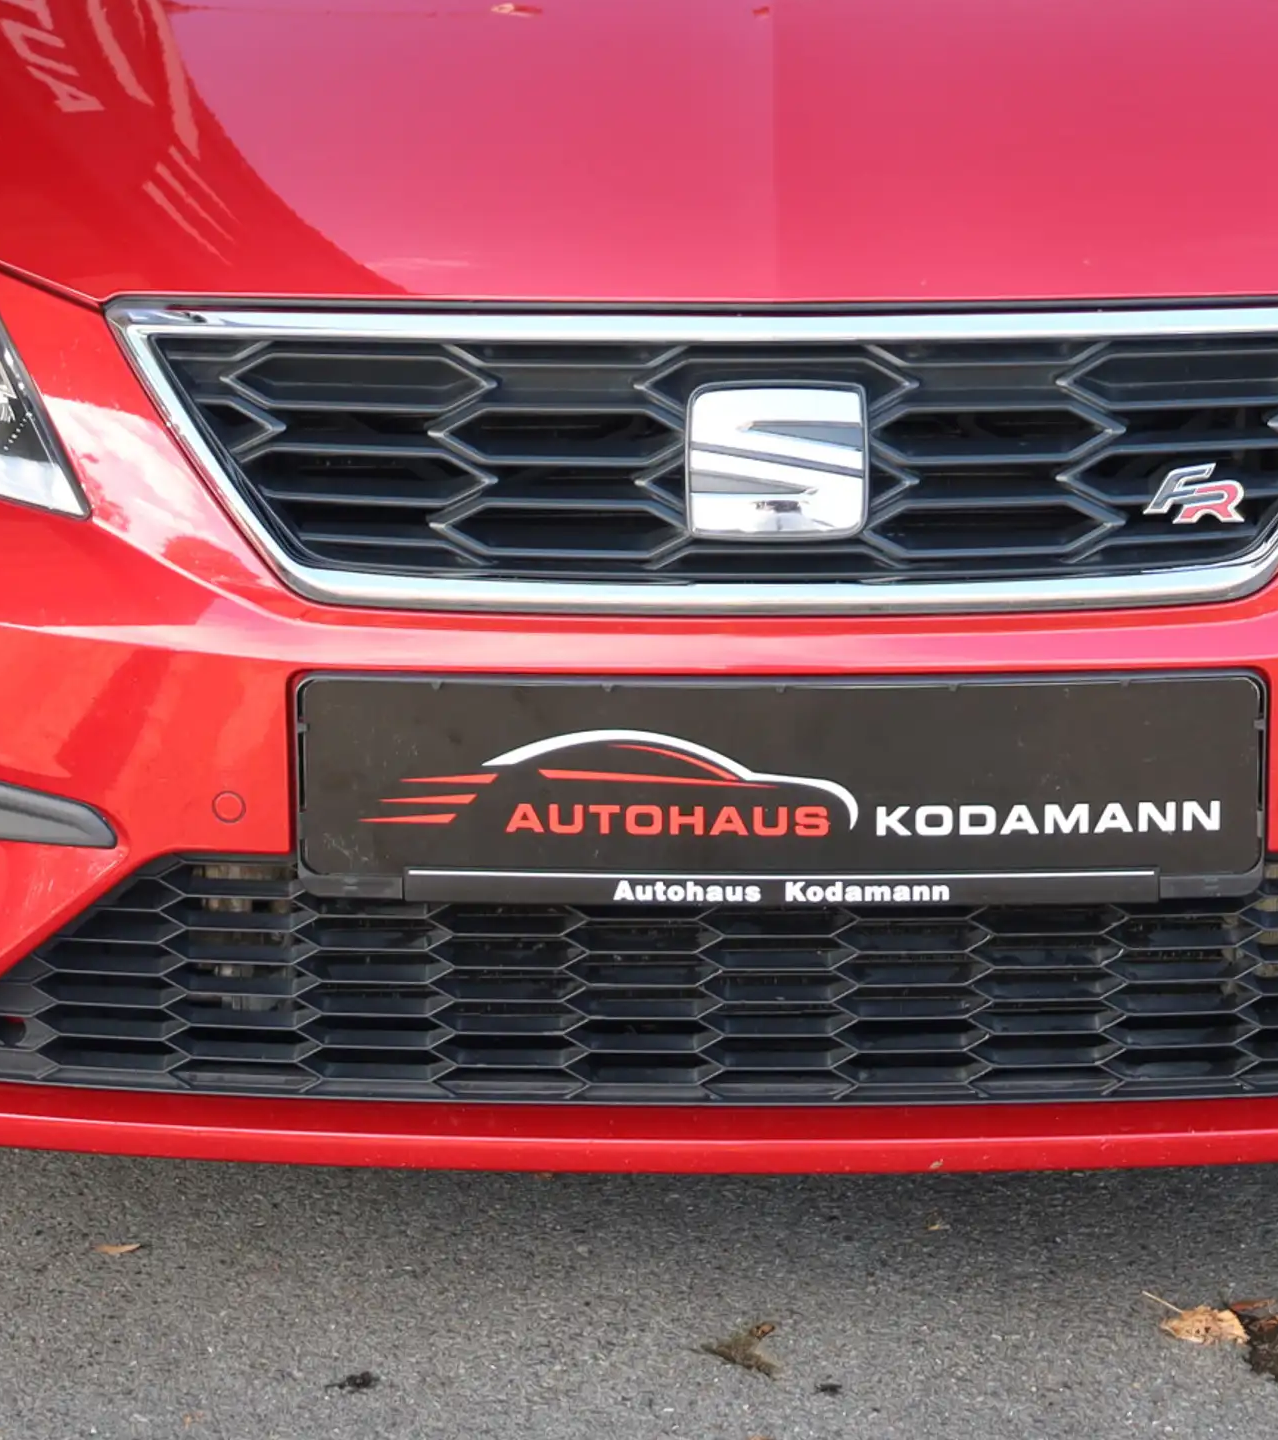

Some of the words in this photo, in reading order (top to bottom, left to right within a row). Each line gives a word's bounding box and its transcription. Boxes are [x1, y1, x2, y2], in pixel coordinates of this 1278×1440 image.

[1143, 462, 1245, 524] FR
[505, 803, 832, 837] AUTOHAUS
[875, 800, 1221, 837] KODAMANN
[613, 879, 762, 903] Autohaus
[784, 880, 950, 903] Kodamann
